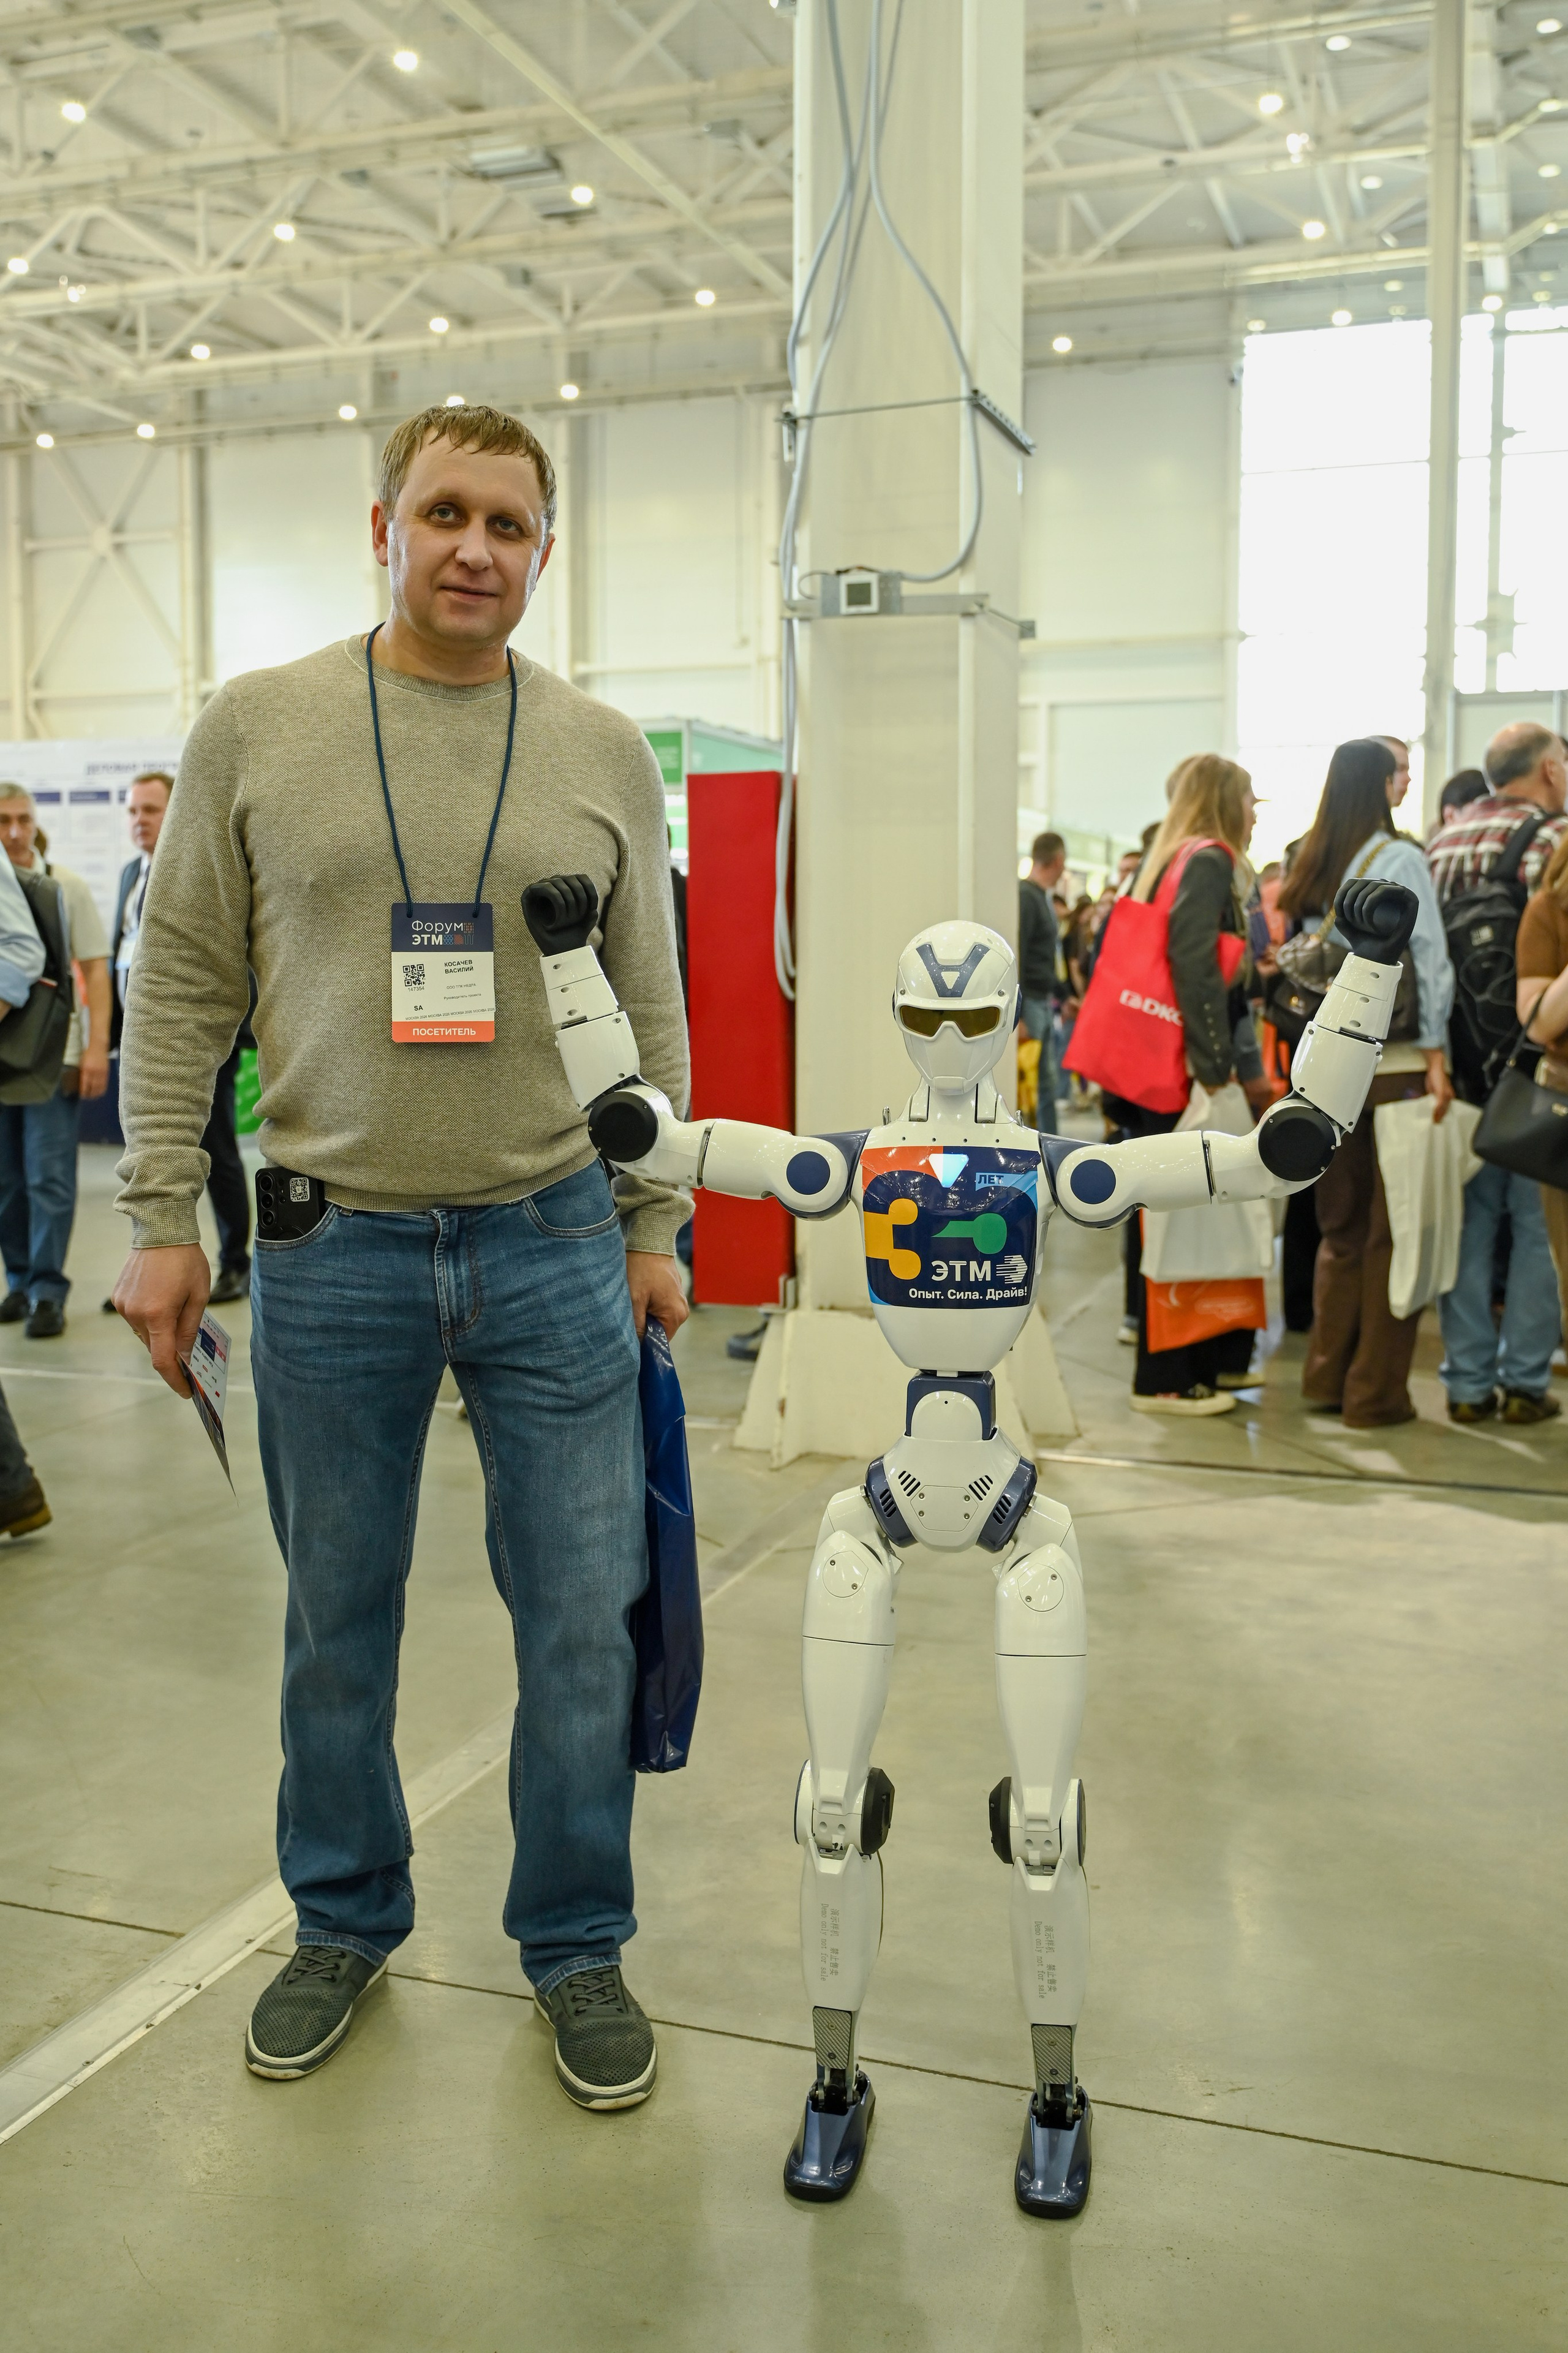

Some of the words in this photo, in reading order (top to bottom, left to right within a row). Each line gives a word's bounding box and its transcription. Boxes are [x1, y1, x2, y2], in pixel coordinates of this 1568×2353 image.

[412, 920, 463, 934] Форум
[412, 934, 443, 945] ЭТМ
[445, 965, 474, 974] ВАСИЛИЙ
[978, 1174, 1004, 1185] ЛЕТ
[931, 1260, 992, 1282] ЭТМ
[909, 1288, 944, 1299] Опыт.
[947, 1289, 982, 1299] Сила.
[986, 1286, 1028, 1301] Драйв!
[1035, 1939, 1044, 1953] only
[1038, 1984, 1047, 1999] sale
